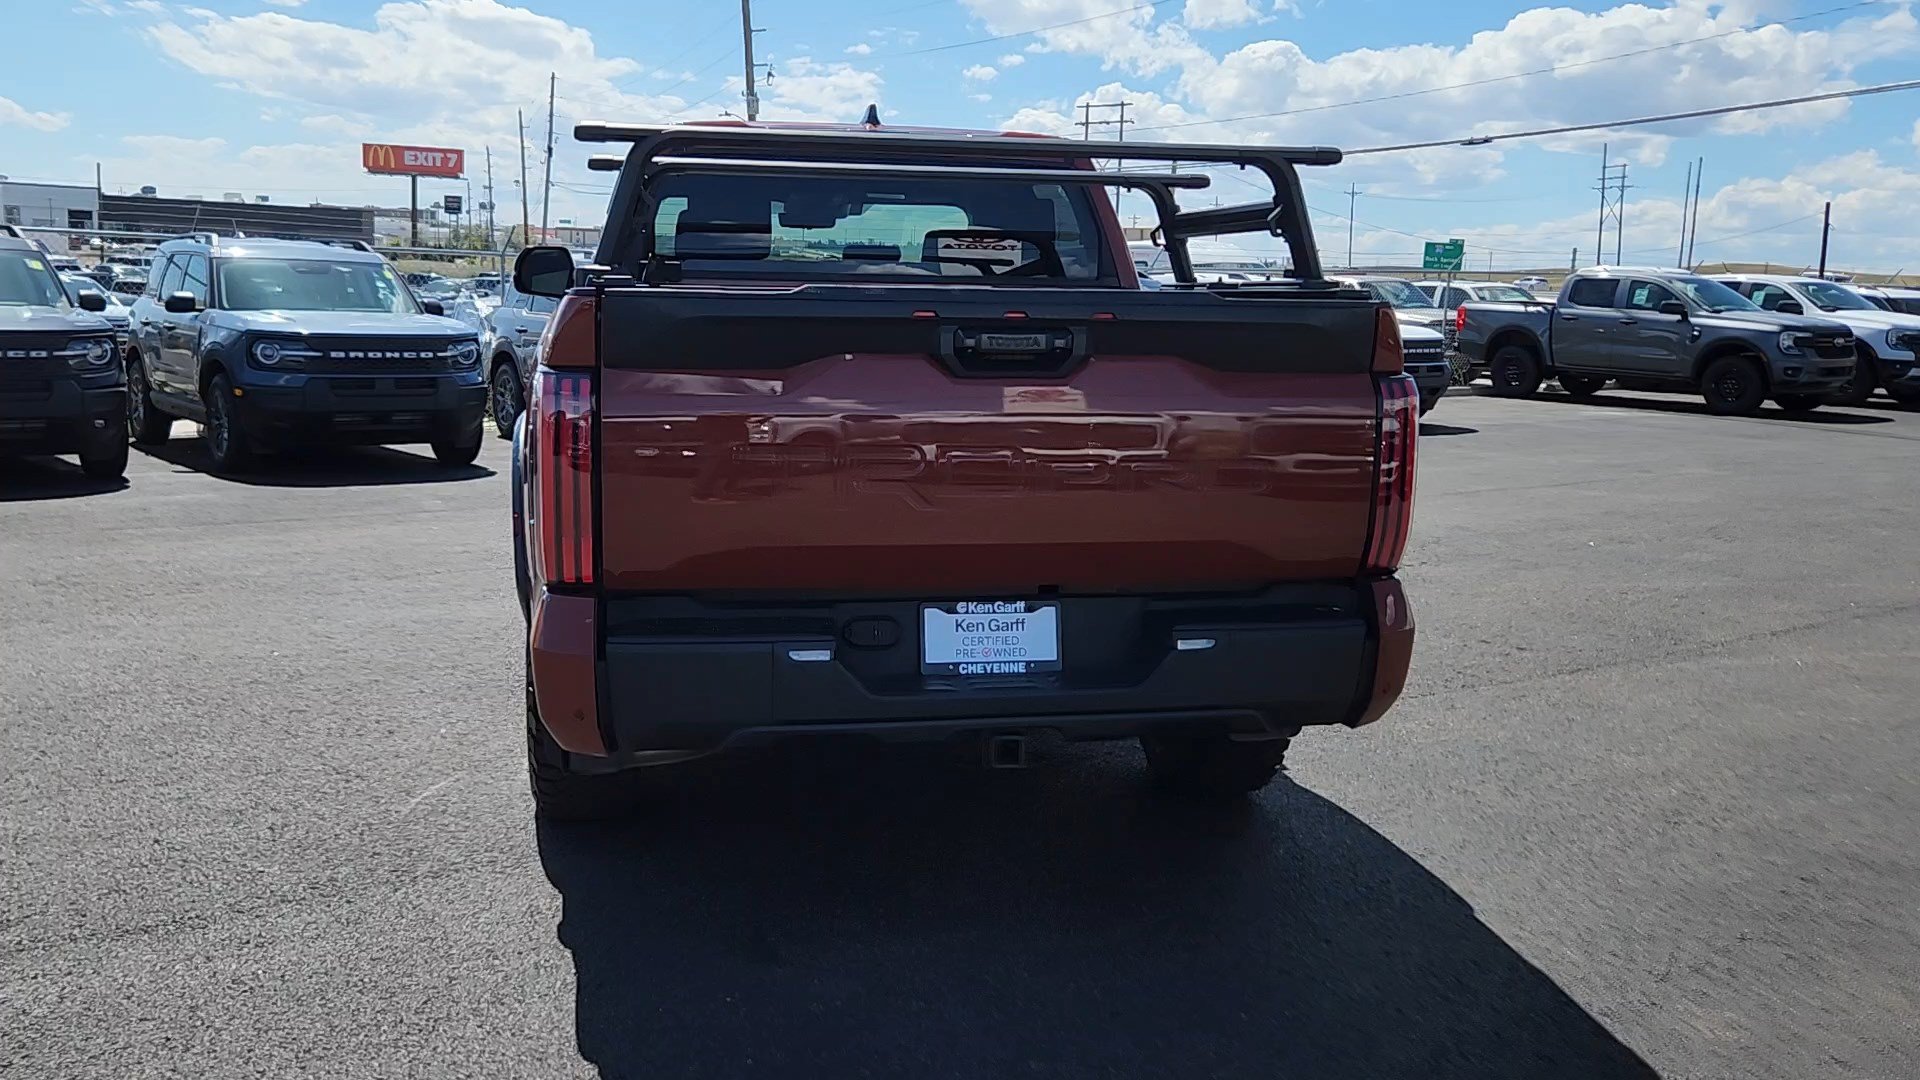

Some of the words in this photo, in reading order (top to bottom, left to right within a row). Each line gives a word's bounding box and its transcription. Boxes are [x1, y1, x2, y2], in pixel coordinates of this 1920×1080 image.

[404, 150, 444, 167] EXIT
[446, 153, 458, 168] 7
[986, 335, 1041, 348] TOYOTA
[968, 602, 993, 613] Ken
[994, 601, 1026, 613] Garff
[955, 618, 985, 633] Ken
[988, 617, 1027, 633] Garff
[962, 635, 1020, 647] CERTIFIED
[958, 662, 1027, 674] CHEYENNE
